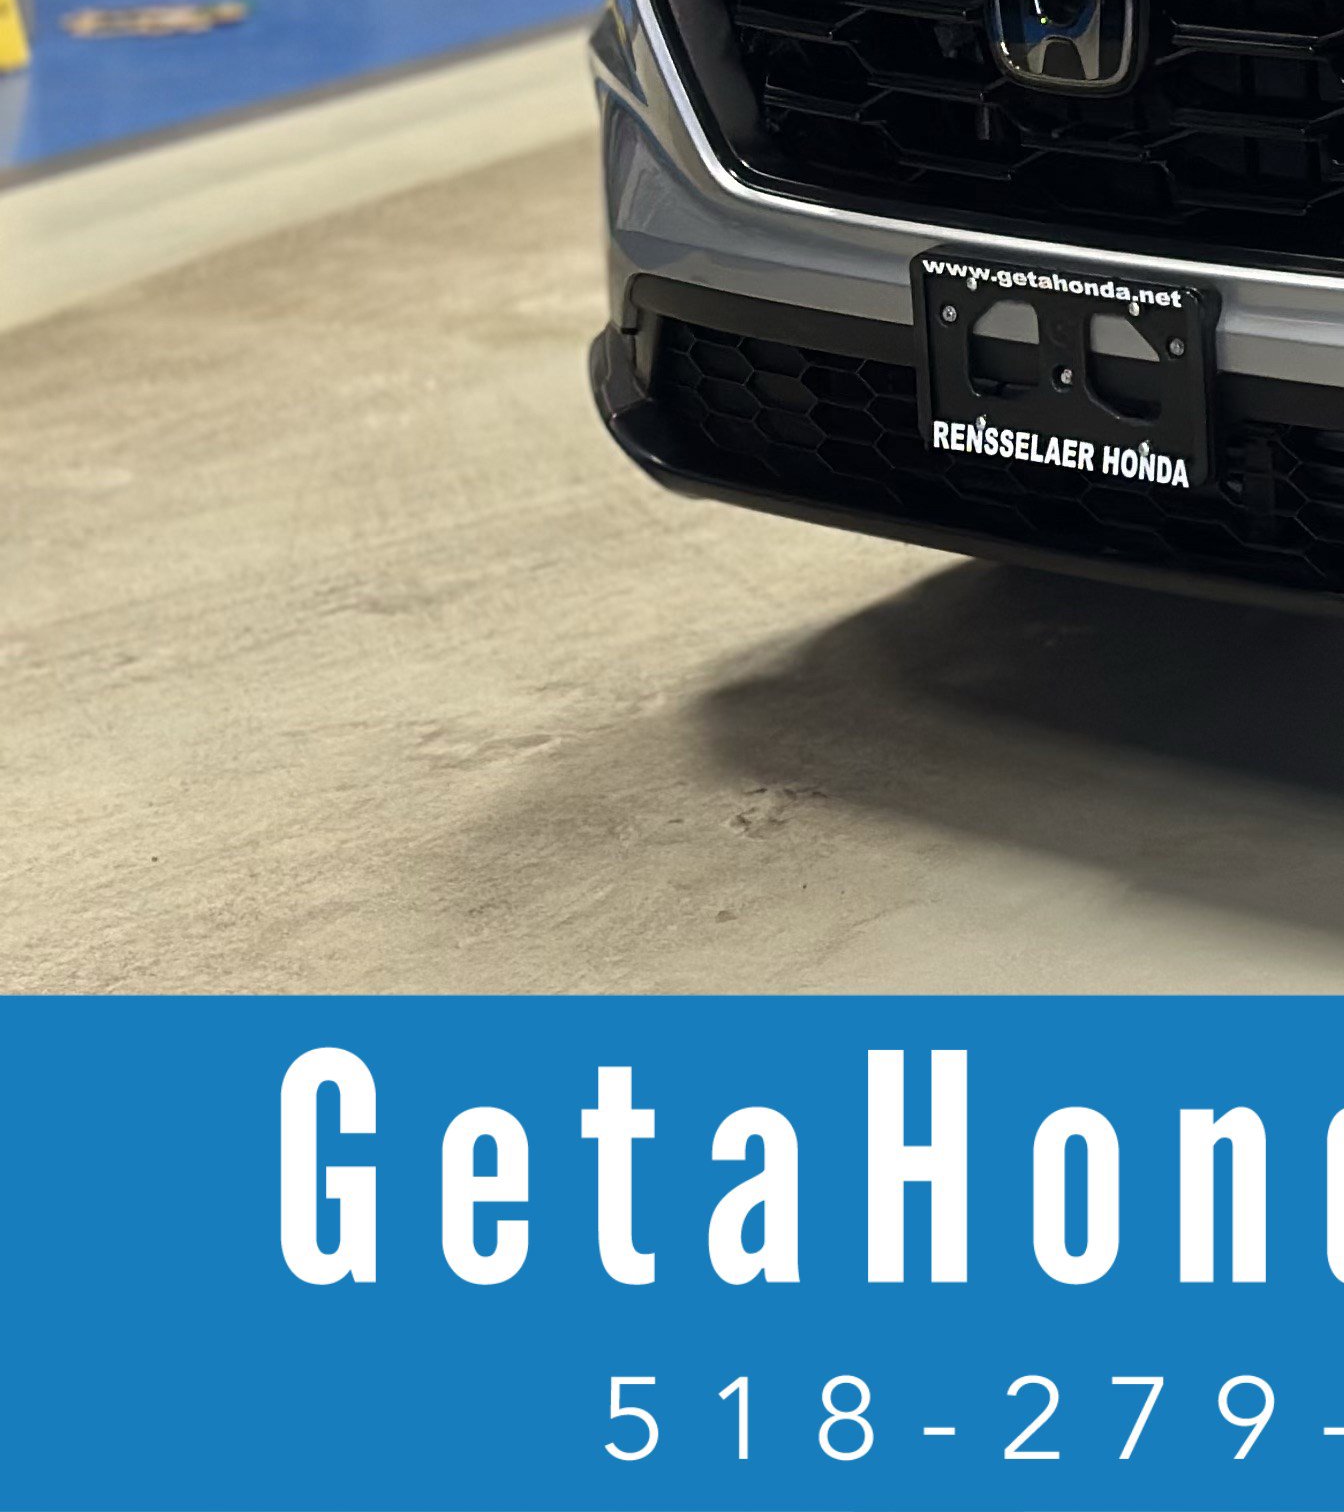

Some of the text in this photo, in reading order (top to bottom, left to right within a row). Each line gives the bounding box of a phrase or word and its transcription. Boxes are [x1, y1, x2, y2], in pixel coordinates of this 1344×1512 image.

[922, 259, 1182, 309] www.getahonda.net
[932, 420, 1190, 489] RENSSELAER HONDA
